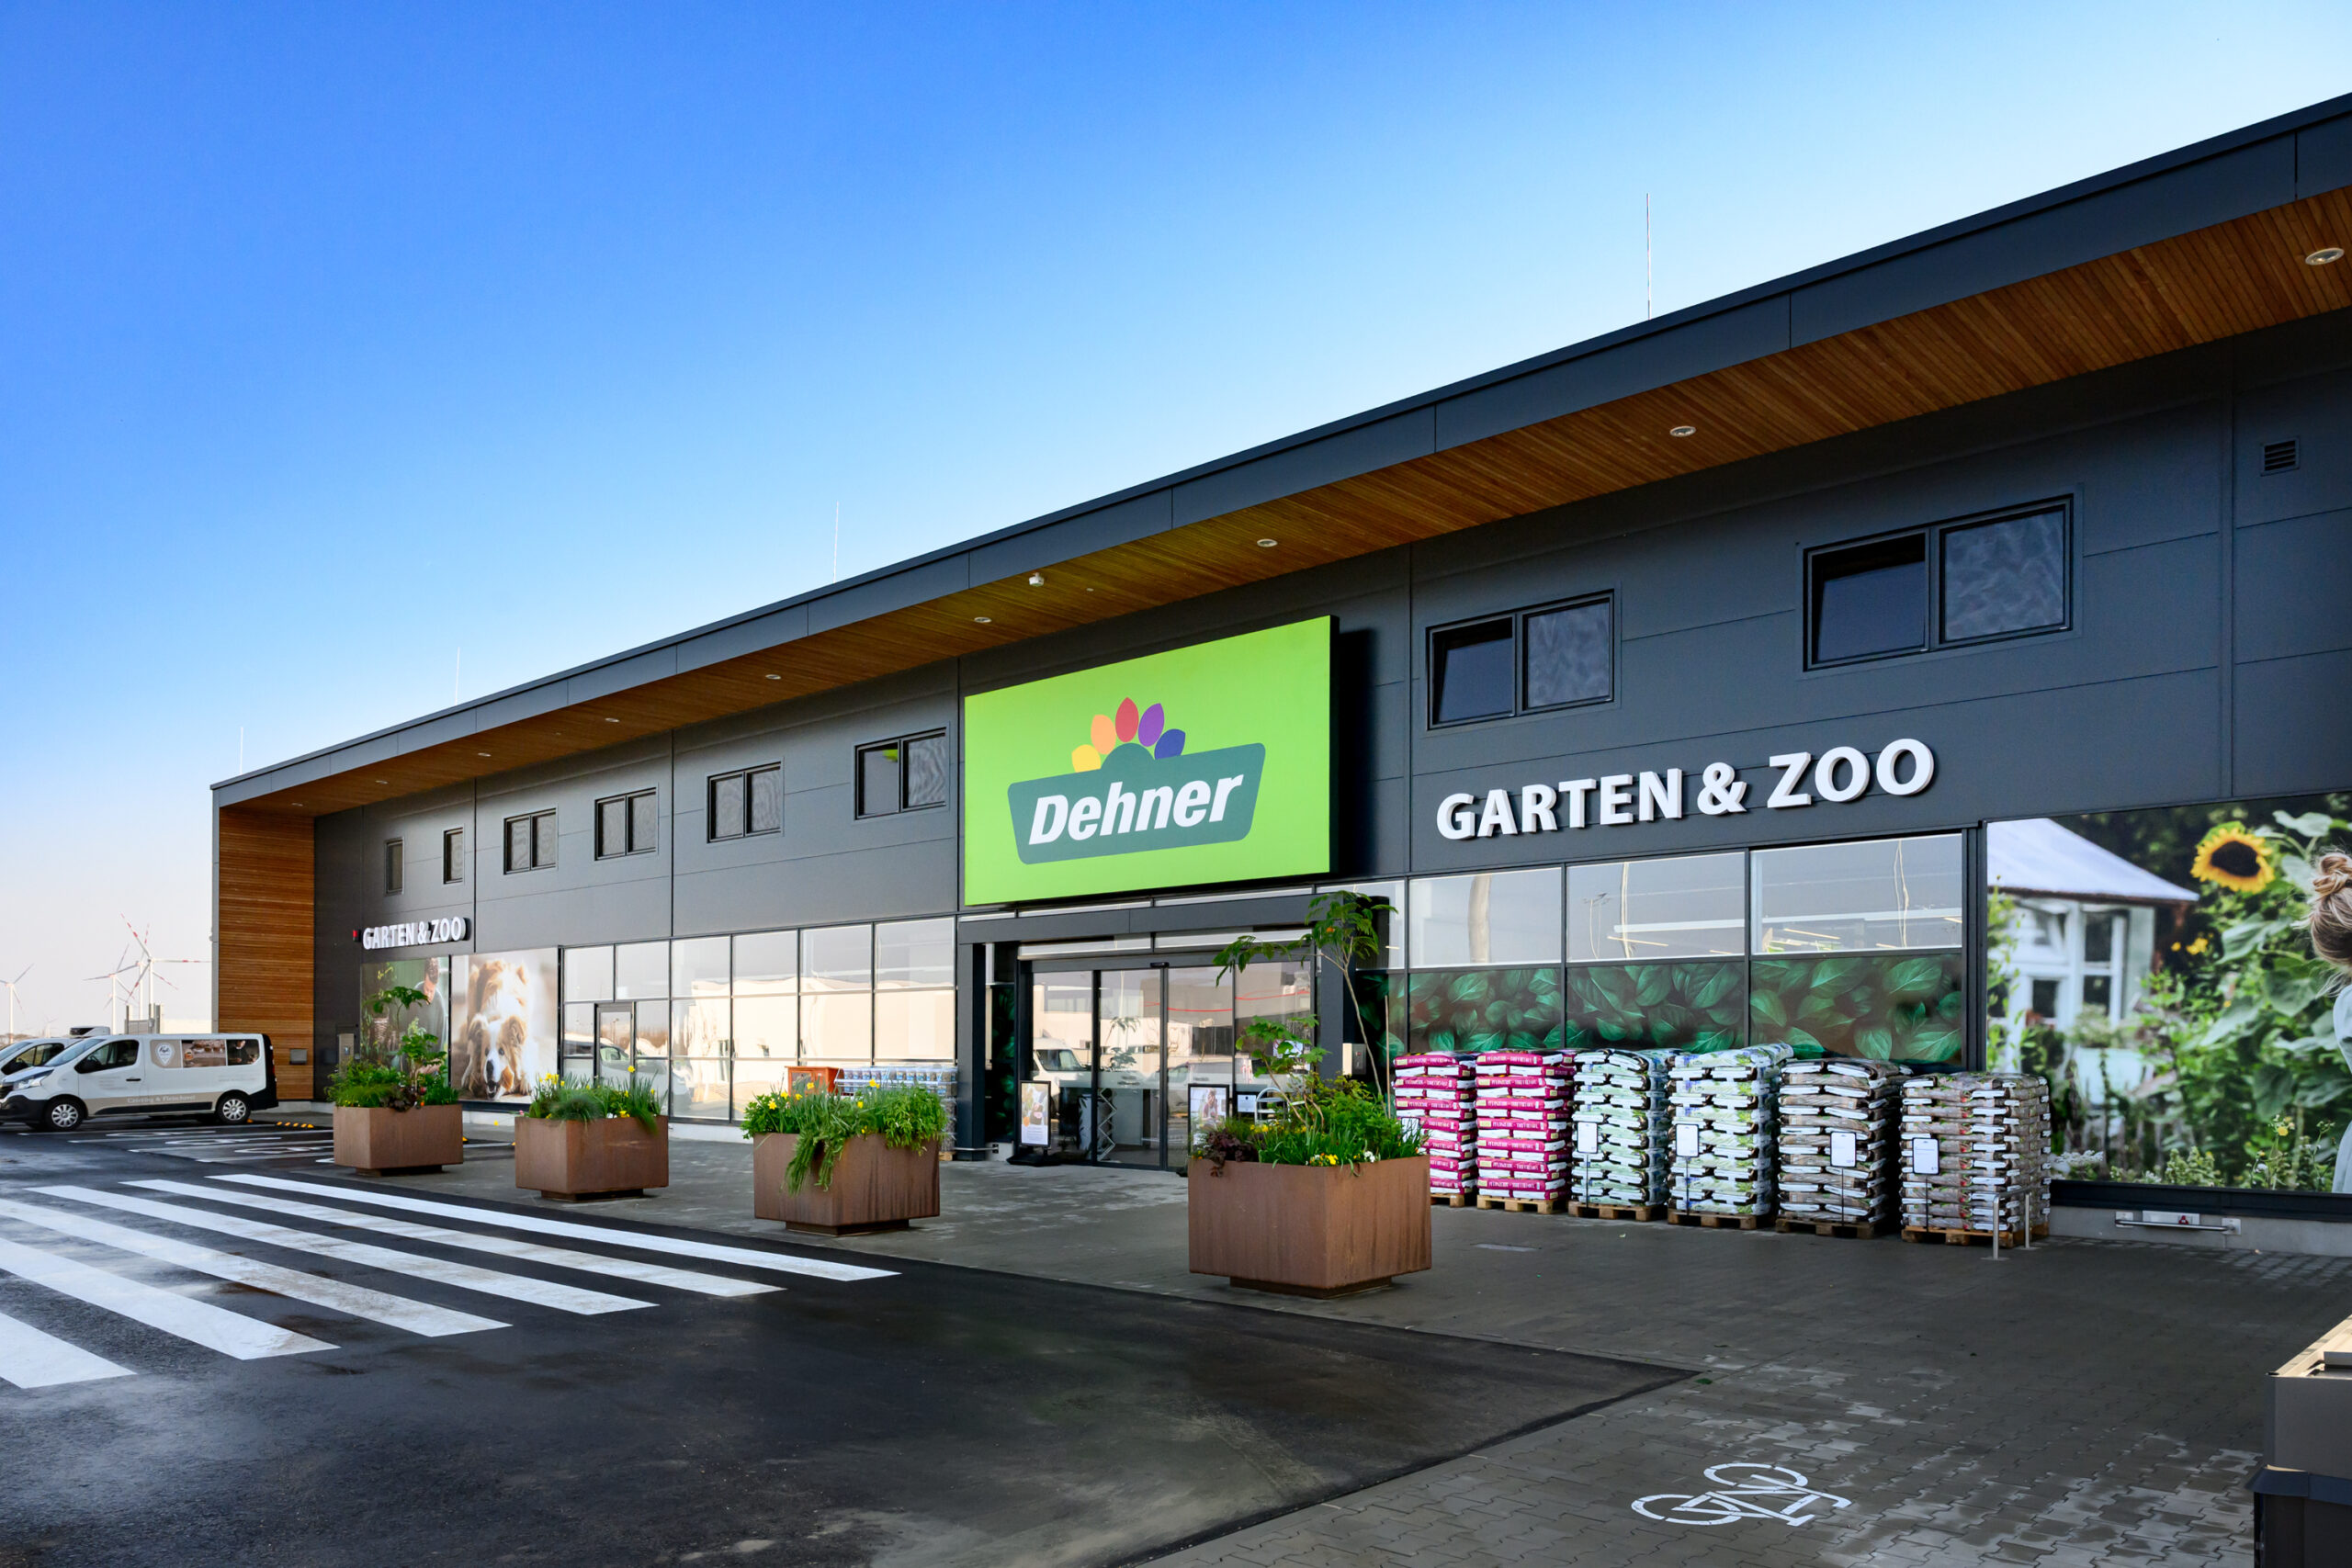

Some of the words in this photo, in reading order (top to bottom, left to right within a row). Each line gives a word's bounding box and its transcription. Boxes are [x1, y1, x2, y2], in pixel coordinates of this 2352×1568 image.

[1028, 774, 1244, 845] Dehner
[1436, 768, 1683, 840] GARTEN
[1697, 761, 1747, 816] &
[1767, 738, 1935, 808] ZOO
[362, 921, 416, 950] GARTEN
[417, 920, 429, 945] &
[430, 917, 465, 943] ZOO
